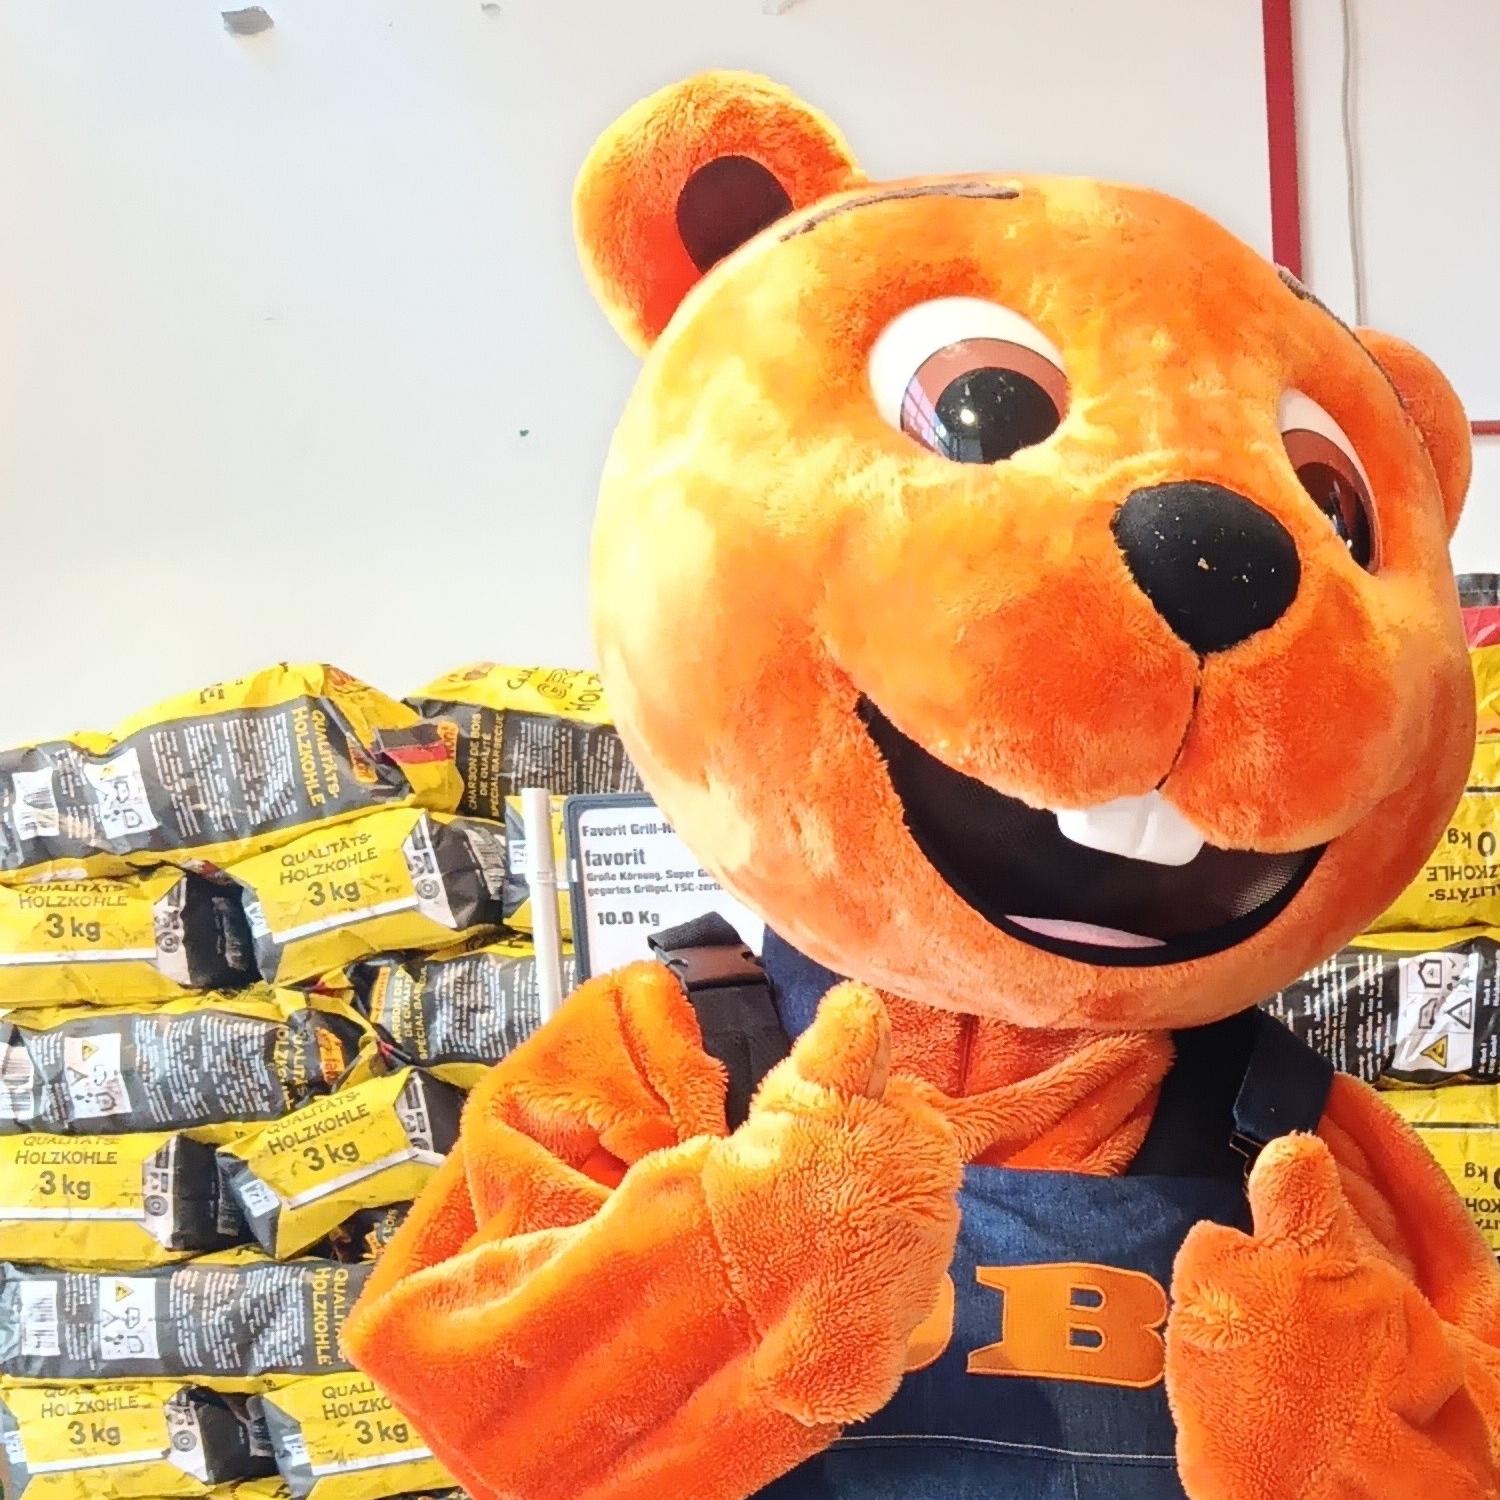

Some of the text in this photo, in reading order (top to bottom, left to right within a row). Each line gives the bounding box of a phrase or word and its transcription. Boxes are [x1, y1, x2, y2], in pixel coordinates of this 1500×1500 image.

[292, 705, 326, 806] HOLZKOHLE
[582, 824, 627, 837] Favorit
[1448, 827, 1472, 850] kg
[281, 834, 372, 867] QUALITÄTS-
[585, 848, 646, 866] favorit
[279, 846, 378, 885] HOLZKOHLE
[666, 869, 694, 880] Super
[18, 895, 128, 910] HOLZKOHLE
[308, 881, 361, 906] 3 kg
[46, 913, 102, 942] 3 kg
[598, 910, 660, 926] 10.0 Kg
[267, 1104, 371, 1156] HOLZKOHLE
[15, 1150, 118, 1165] HOLZKOHLE
[302, 1140, 361, 1171] 3 kg
[1463, 1161, 1489, 1181] kg
[39, 1171, 92, 1200] 3 kg
[312, 1267, 333, 1365] HOLZKOHLE
[321, 1381, 375, 1400] QUALI
[41, 1396, 138, 1419] HOLZKOHLE
[321, 1395, 394, 1420] HOLZKO
[67, 1421, 121, 1446] 3 kg
[354, 1420, 409, 1445] 3 kg
